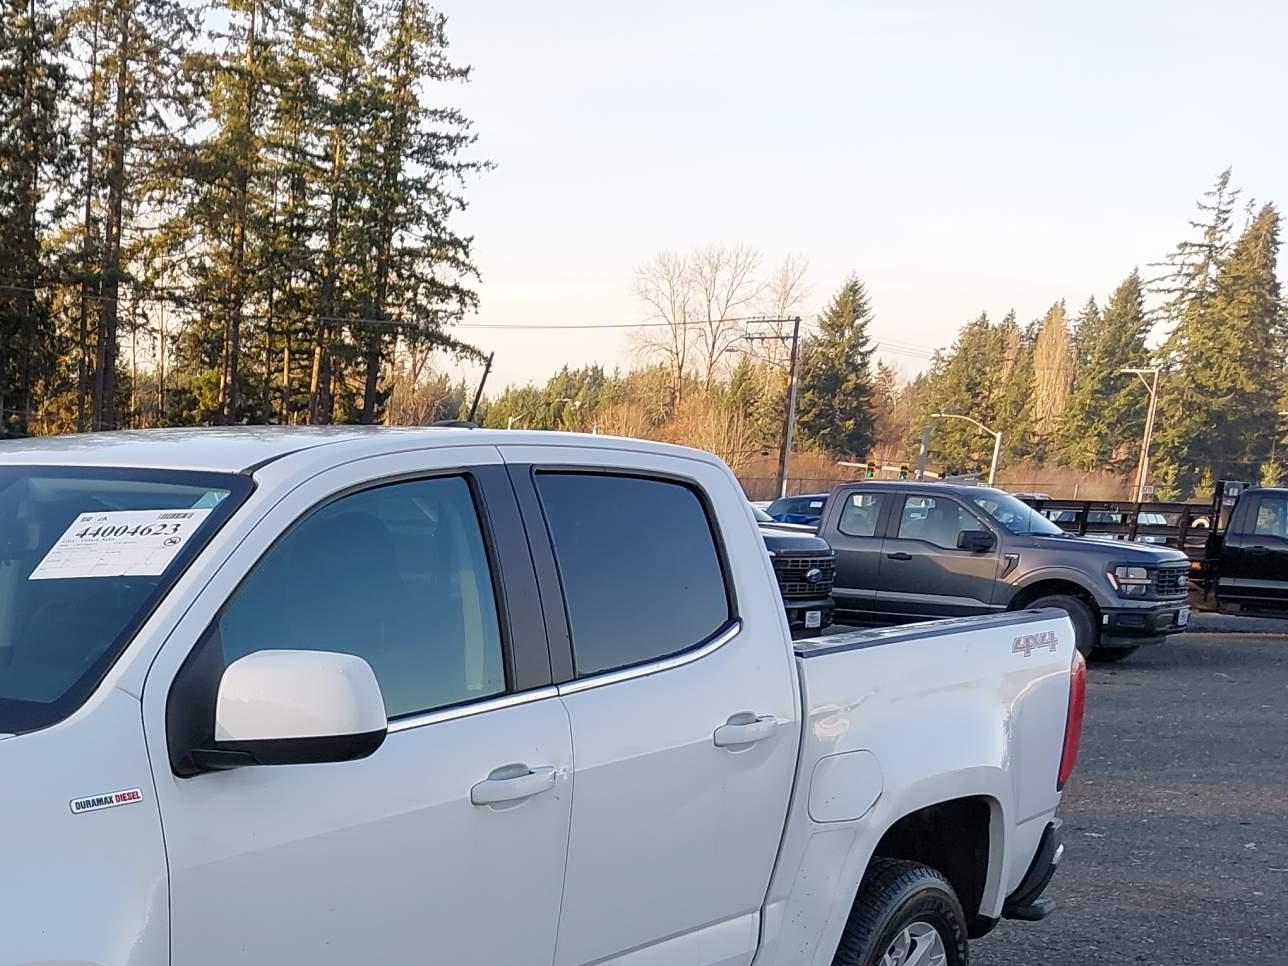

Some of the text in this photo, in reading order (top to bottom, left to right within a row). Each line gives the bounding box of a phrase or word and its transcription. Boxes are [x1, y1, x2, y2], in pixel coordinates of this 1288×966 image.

[74, 523, 182, 539] 44004623
[74, 790, 141, 810] DURAMAX DIESEL
